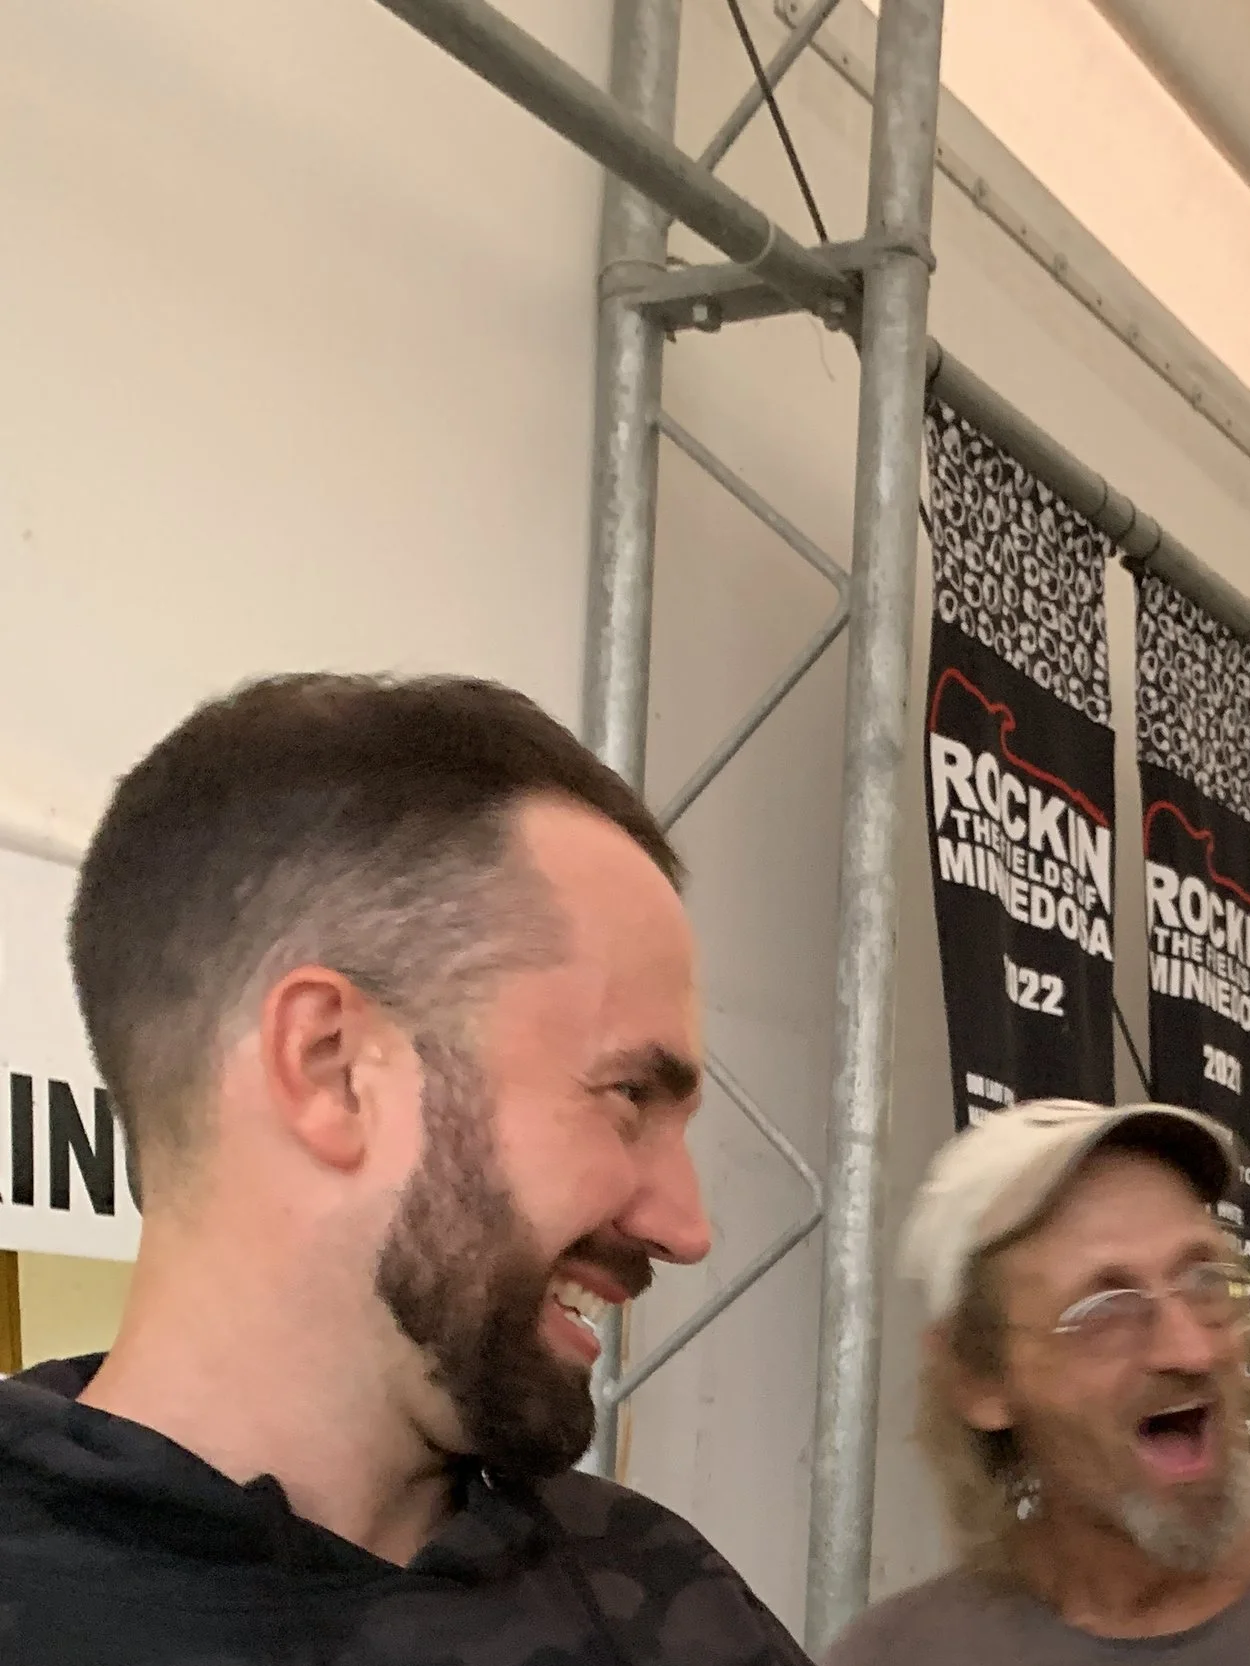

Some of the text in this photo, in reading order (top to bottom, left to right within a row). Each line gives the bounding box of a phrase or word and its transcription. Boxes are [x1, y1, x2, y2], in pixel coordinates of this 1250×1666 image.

[930, 732, 1111, 915] ROCKIN
[951, 809, 1001, 853] THE
[1153, 927, 1203, 963] THE
[0, 1071, 142, 1218] IN
